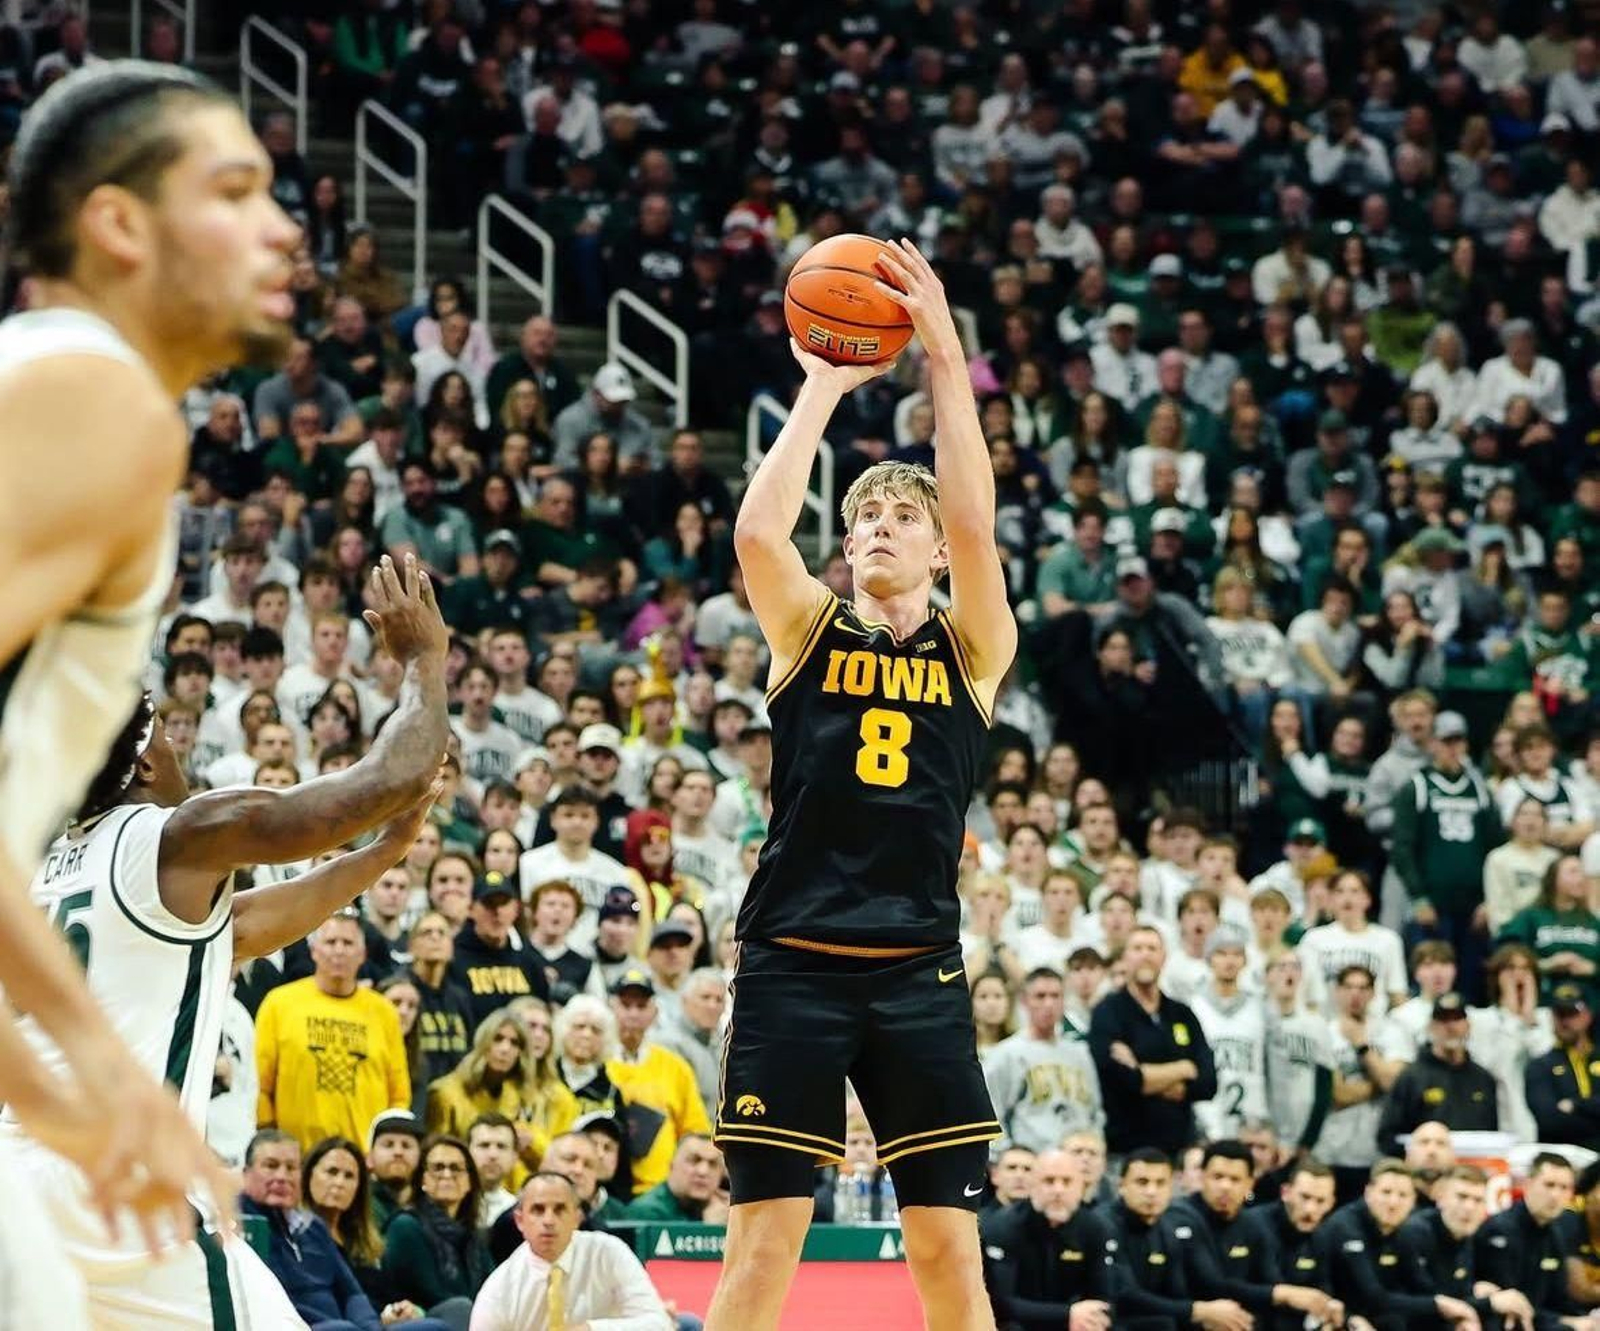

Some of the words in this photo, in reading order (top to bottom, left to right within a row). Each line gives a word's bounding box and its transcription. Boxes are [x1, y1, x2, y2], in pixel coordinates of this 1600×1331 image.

[807, 326, 880, 357] ELITE
[822, 649, 952, 706] IOWA
[855, 707, 913, 788] 8
[43, 843, 89, 885] CARR
[1225, 1082, 1244, 1116] 2
